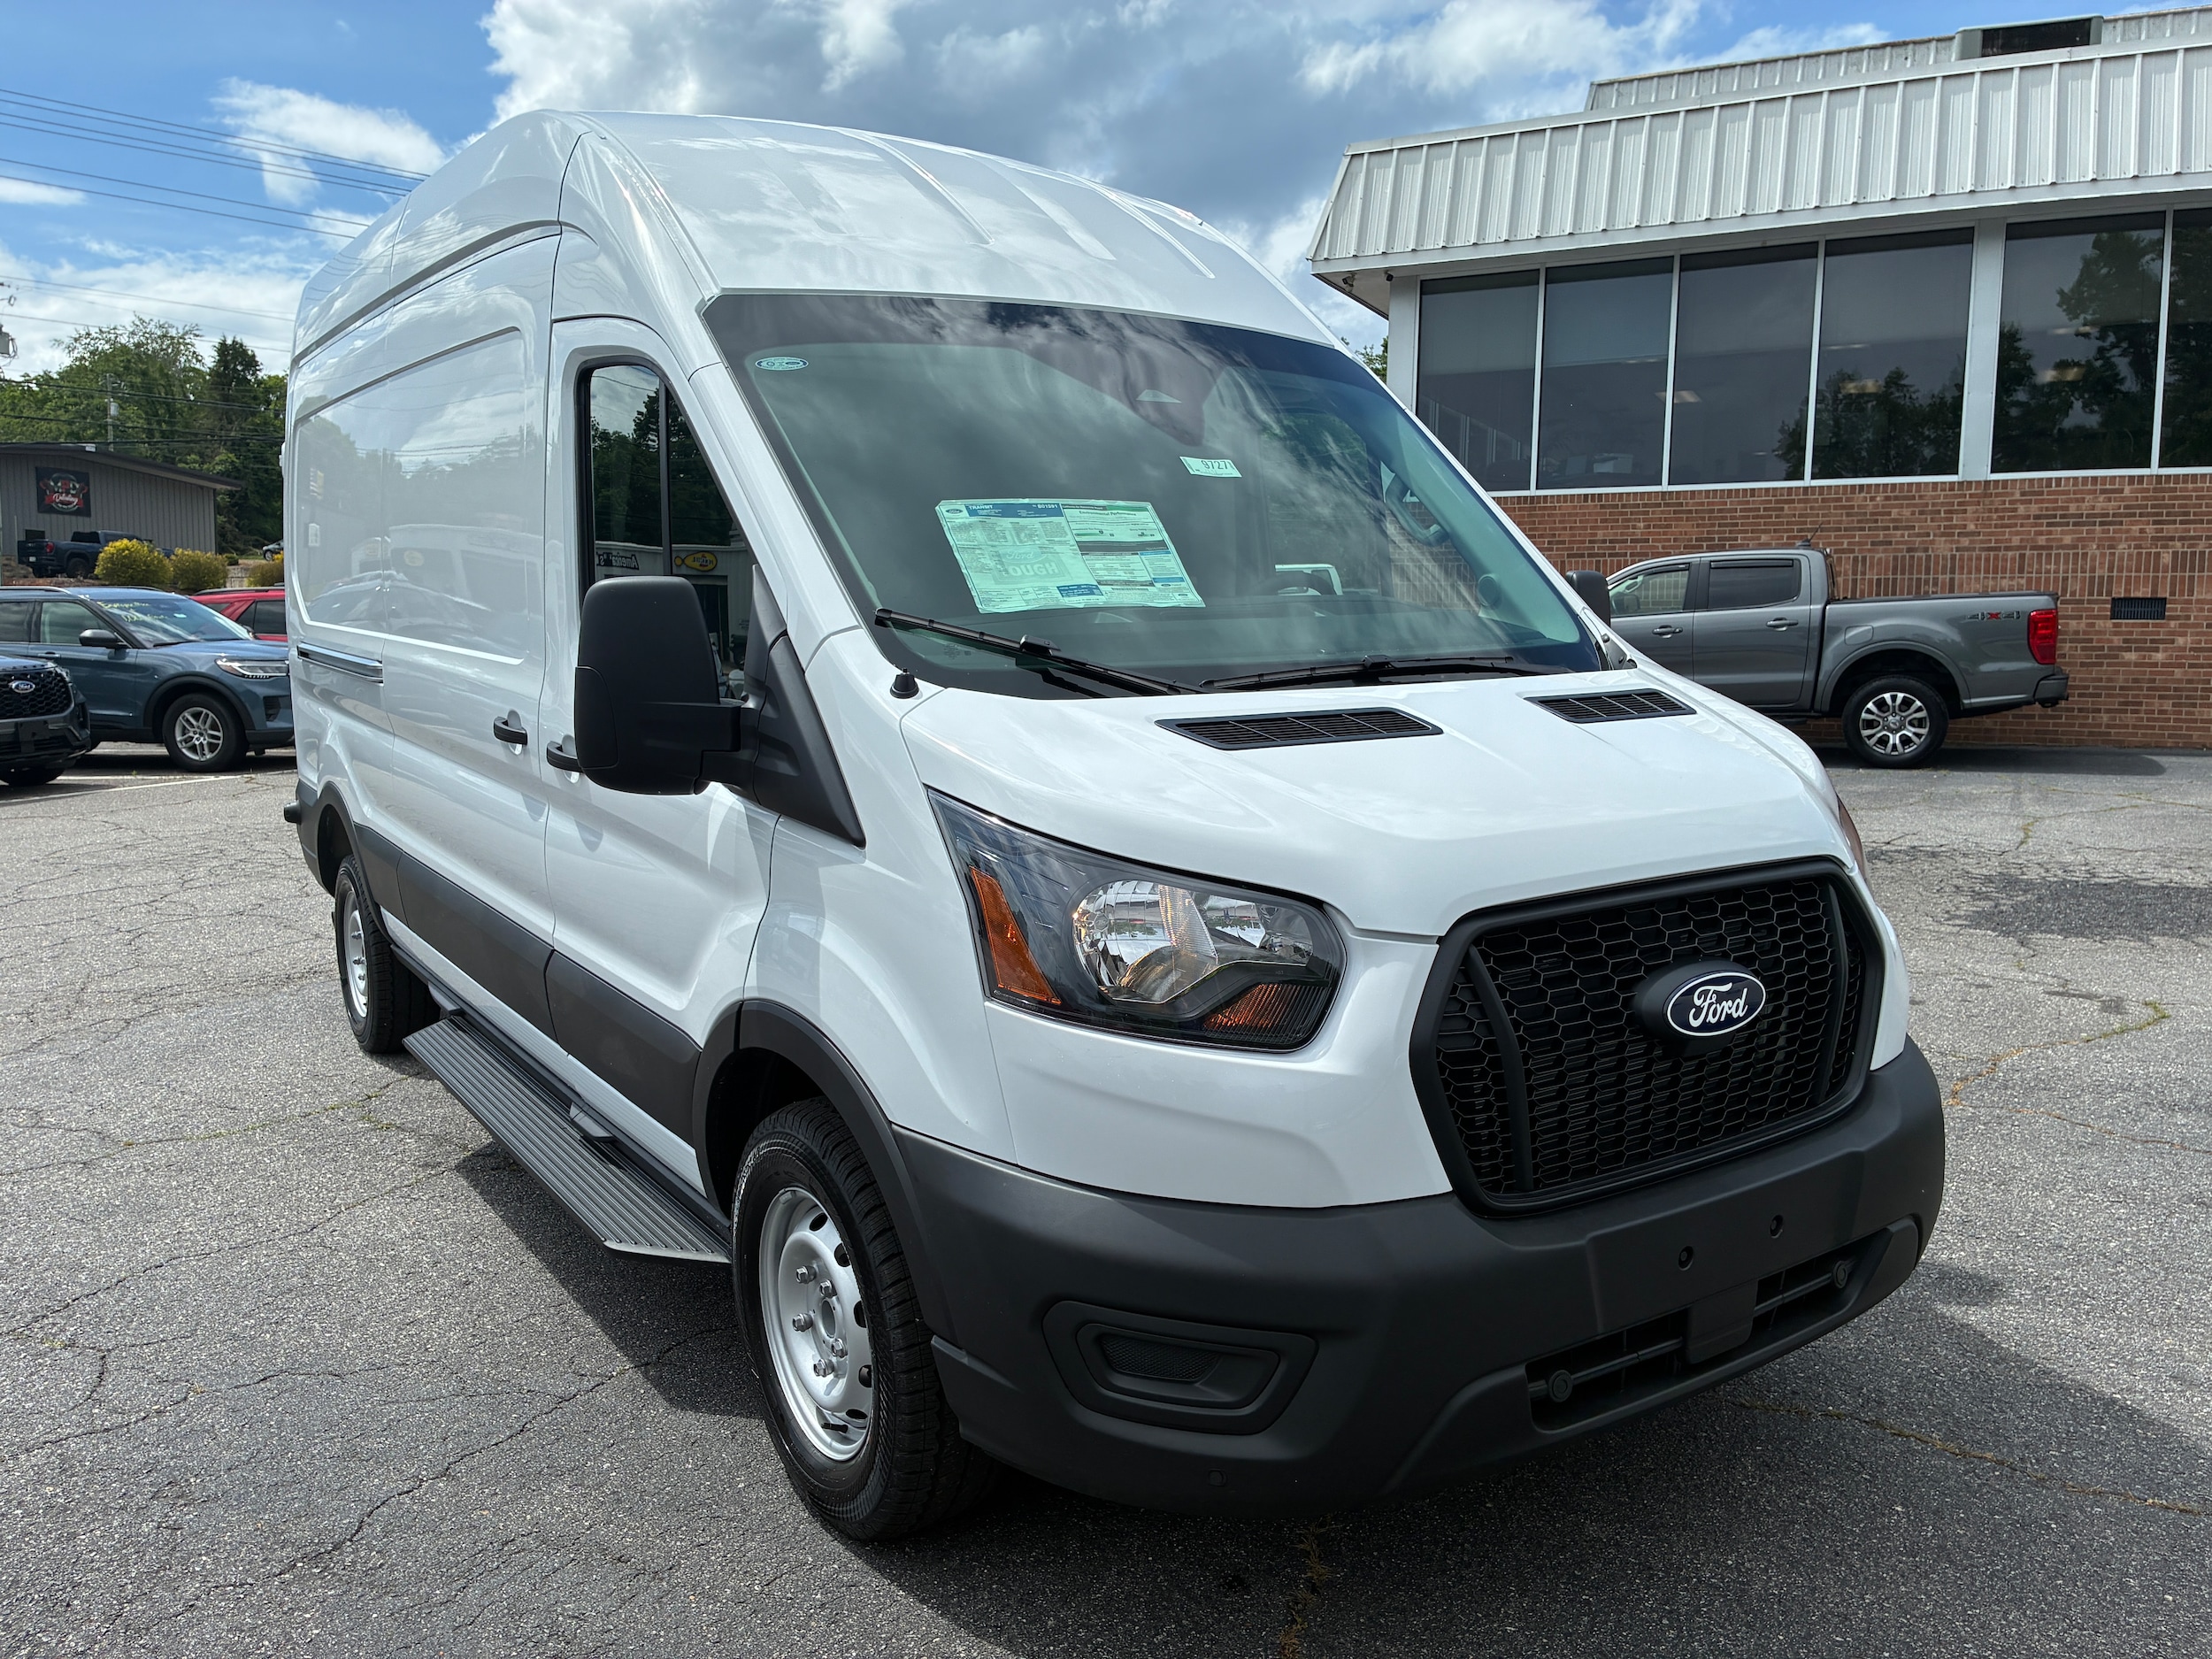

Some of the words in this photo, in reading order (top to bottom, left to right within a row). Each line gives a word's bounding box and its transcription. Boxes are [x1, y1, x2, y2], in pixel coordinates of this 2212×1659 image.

[1201, 460, 1228, 470] 9727
[1003, 562, 1059, 576] OUGH
[1688, 982, 1748, 1028] Ford
